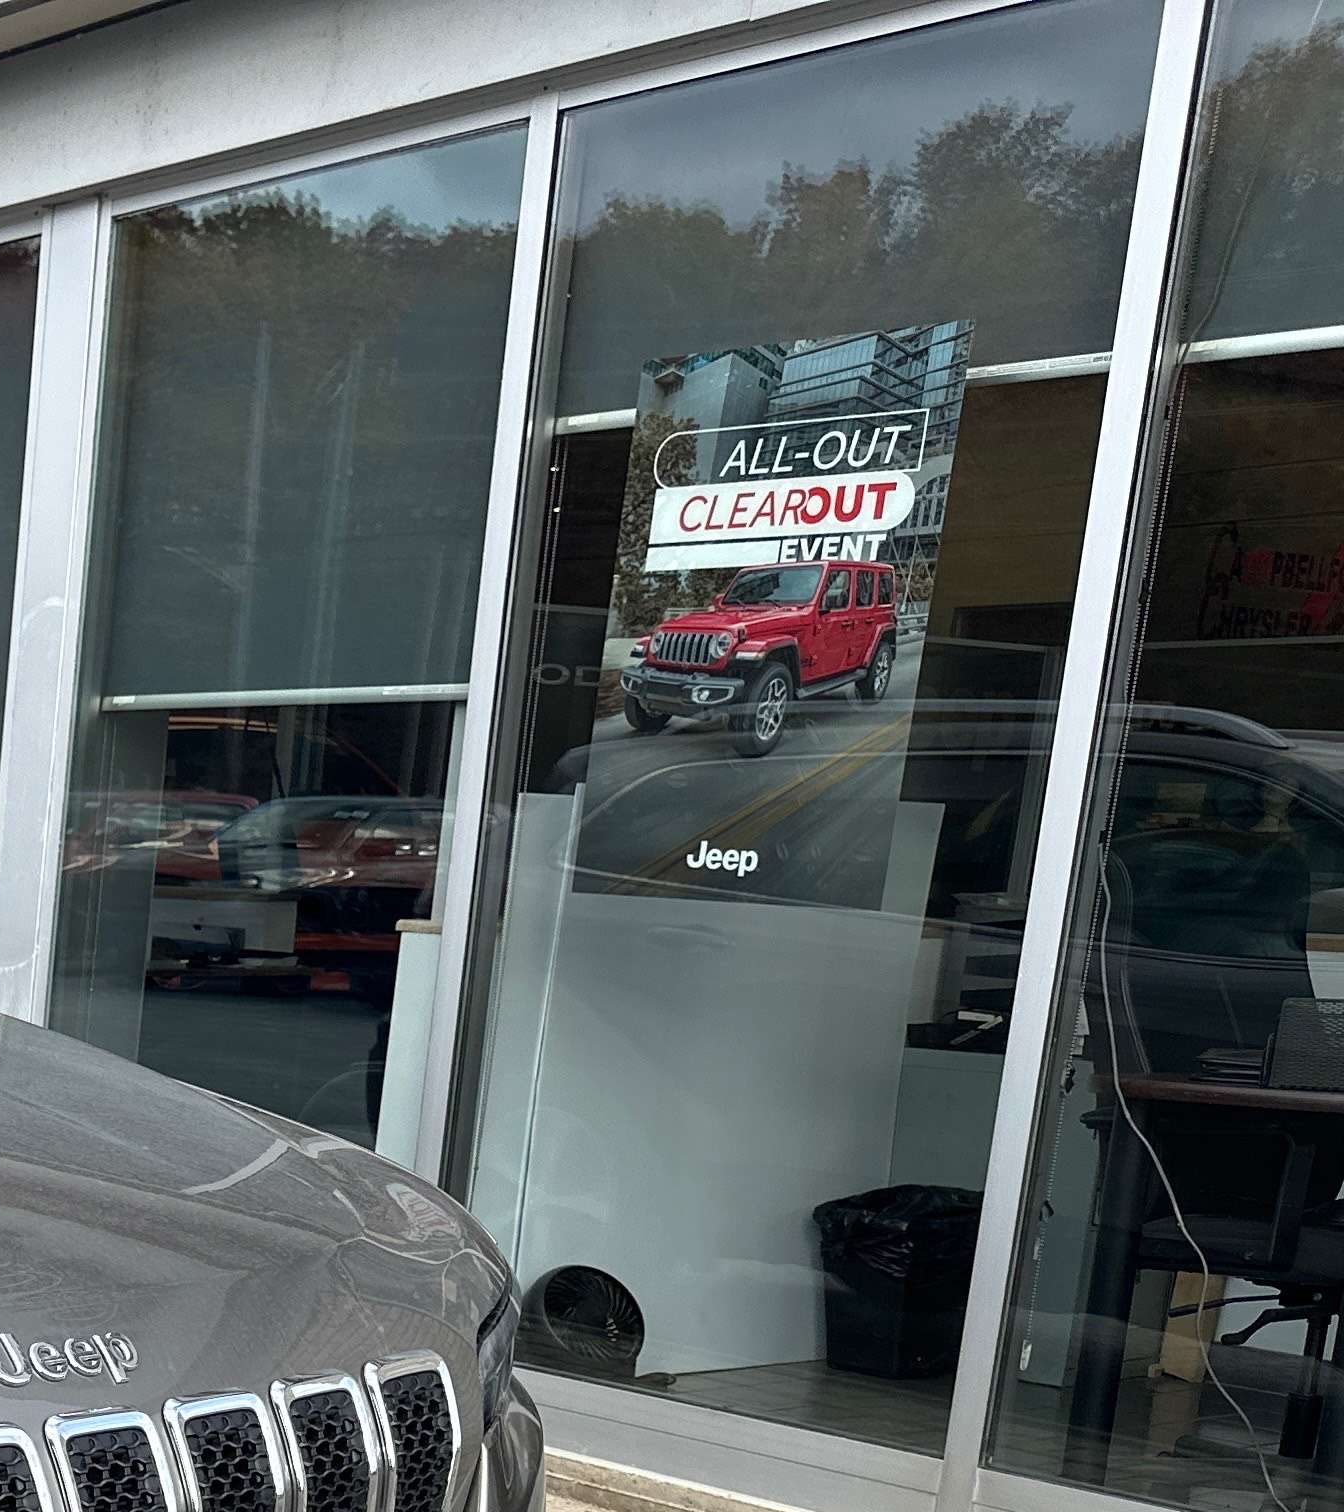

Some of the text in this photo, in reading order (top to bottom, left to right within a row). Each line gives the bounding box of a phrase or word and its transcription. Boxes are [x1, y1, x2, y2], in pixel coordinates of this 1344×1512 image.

[719, 425, 914, 478] ALL-OUT
[678, 482, 898, 533] CLEAROUT
[779, 534, 887, 563] EVENT
[686, 840, 759, 877] Jeep
